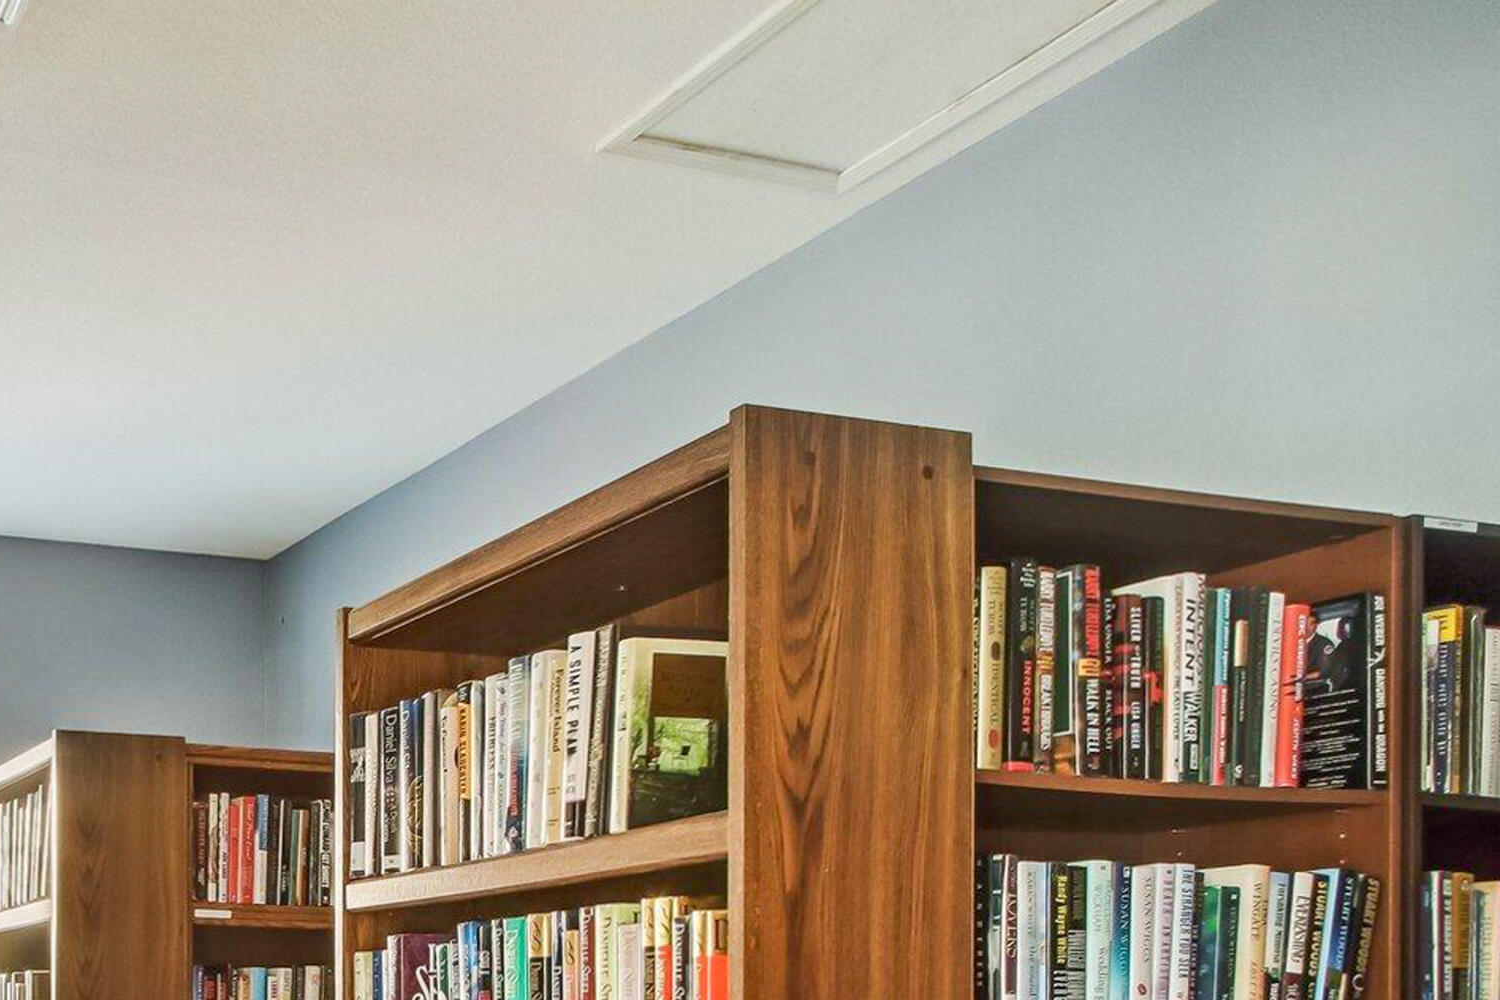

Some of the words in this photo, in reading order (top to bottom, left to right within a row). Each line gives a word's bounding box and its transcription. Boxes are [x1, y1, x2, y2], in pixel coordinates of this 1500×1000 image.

[1040, 572, 1053, 600] HARRY
[1039, 602, 1053, 653] TURTLEDOVE
[1085, 601, 1099, 657] TURTLEDOVE
[1104, 597, 1115, 620] LISA
[1130, 606, 1142, 641] SLIVER
[1104, 624, 1112, 664] UNGER
[1185, 599, 1196, 686] INTENT
[1375, 614, 1384, 646] WEBER
[554, 668, 564, 715] Forever
[567, 660, 582, 712] SIMPLE
[1130, 657, 1142, 689] TRUTH
[1376, 668, 1385, 708] DANCING
[990, 662, 1000, 726] IDENTICAL
[1023, 660, 1032, 735] INNOCENT
[1039, 674, 1052, 751] BREAKTHROUGHS
[1086, 679, 1100, 710] WALK
[1130, 701, 1141, 720] LISA
[384, 714, 398, 753] Daniel
[552, 716, 562, 753] Island
[1086, 713, 1099, 723] IN
[1130, 722, 1141, 750] UNGER
[1183, 691, 1198, 742] WALKER
[567, 720, 577, 757] PLAN
[1086, 727, 1099, 754] HELL
[1376, 734, 1386, 772] DRAGON
[384, 756, 398, 784] Silva
[1056, 876, 1068, 903] Randy
[1182, 869, 1194, 886] THE
[1120, 887, 1129, 929] SUSAN
[1181, 887, 1194, 935] STRANGER
[1251, 882, 1262, 941] WINGATE
[1313, 881, 1328, 926] STUART
[1340, 877, 1355, 921] STUART
[1362, 878, 1381, 924] STUART
[581, 914, 592, 964] DANIELLE
[1057, 906, 1068, 935] Wayne
[1291, 895, 1309, 964] EVERLASTING
[674, 924, 685, 984] DANIELLE
[1057, 937, 1067, 964] White
[1120, 934, 1128, 976] WIGGS
[1143, 920, 1151, 964] WIGGS
[1179, 938, 1191, 958] YOU
[1308, 930, 1323, 977] WOODS
[1335, 925, 1349, 970] WOODS
[1356, 925, 1374, 973] WOODS
[582, 966, 592, 993] STEEL
[1096, 947, 1107, 993] wedding
[1178, 960, 1189, 979] SEEK
